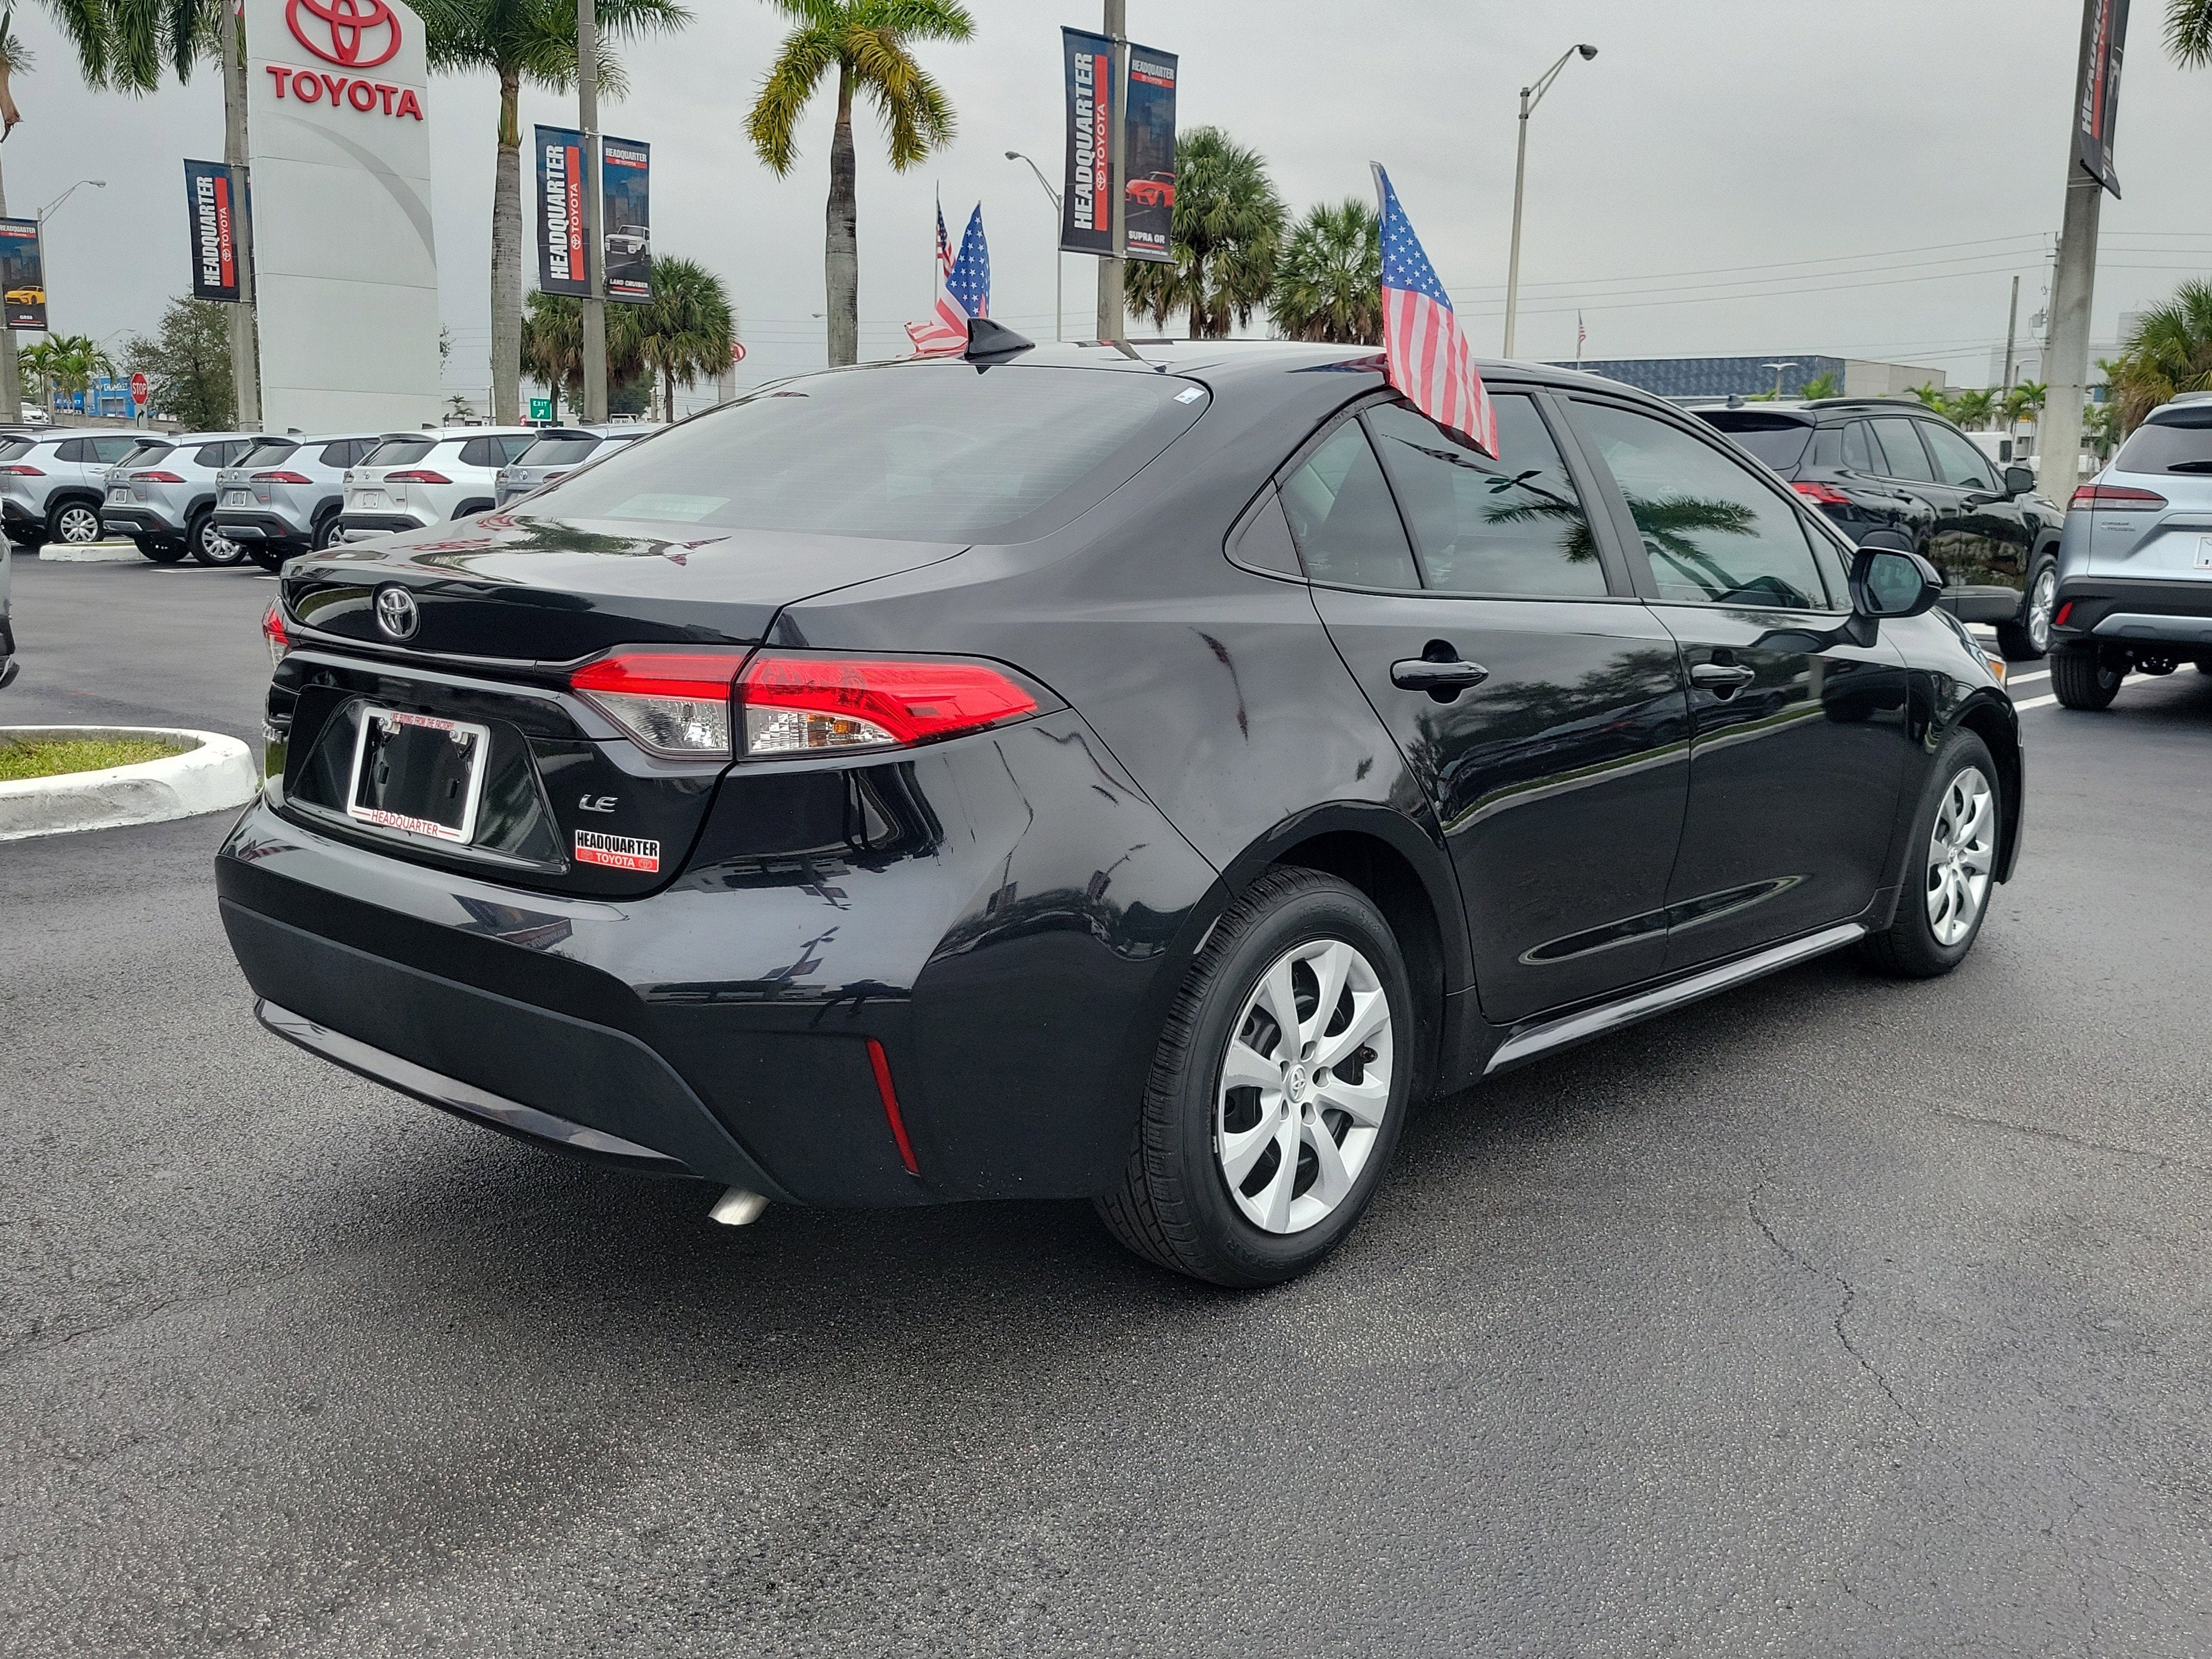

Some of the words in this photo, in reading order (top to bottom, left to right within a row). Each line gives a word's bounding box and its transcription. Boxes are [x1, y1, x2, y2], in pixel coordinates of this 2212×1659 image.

[1132, 59, 1173, 80] HEADQUARTER
[266, 66, 424, 120] TOYOTA
[1074, 53, 1095, 230] HEADQUARTER
[1097, 103, 1105, 170] TOYOTA
[606, 148, 647, 162] HEADQUARTER
[546, 144, 569, 280] HEADQUARTER
[571, 183, 579, 233] TOYOTA
[0, 224, 36, 234] HEADQUARTER
[196, 176, 221, 286] HEADQUARTER
[219, 207, 230, 248] TOYOTA
[1128, 230, 1153, 242] SUPRA
[1154, 234, 1165, 244] GR
[132, 382, 147, 396] STOP
[579, 794, 618, 812] LE
[371, 810, 438, 836] HEADQUARTER
[577, 831, 658, 857] HEADQUARTER
[596, 853, 635, 867] TOYOTA
